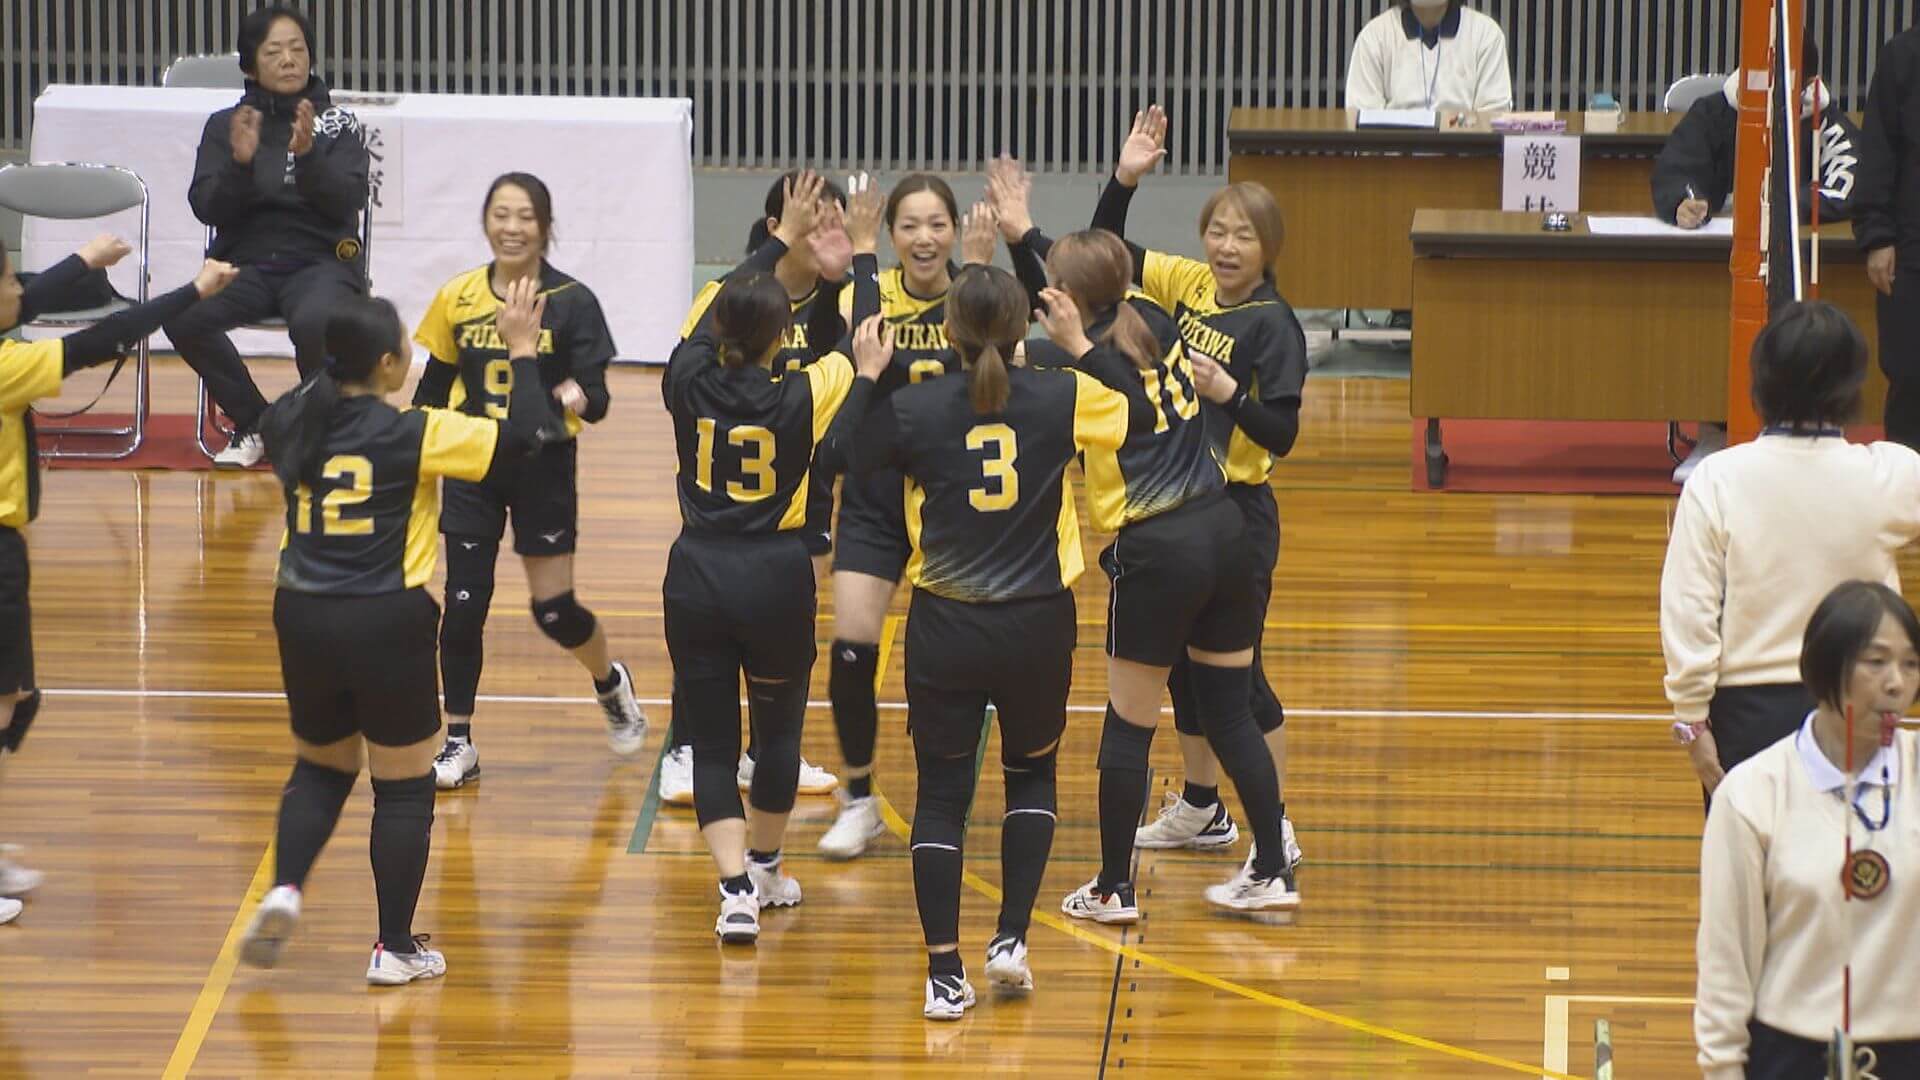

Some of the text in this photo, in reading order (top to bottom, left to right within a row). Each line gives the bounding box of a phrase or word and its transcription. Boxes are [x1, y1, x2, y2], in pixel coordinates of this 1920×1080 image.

[484, 359, 514, 419] 9
[1138, 338, 1200, 434] 10
[293, 453, 375, 535] 12
[695, 417, 777, 502] 13
[965, 422, 1019, 512] 3
